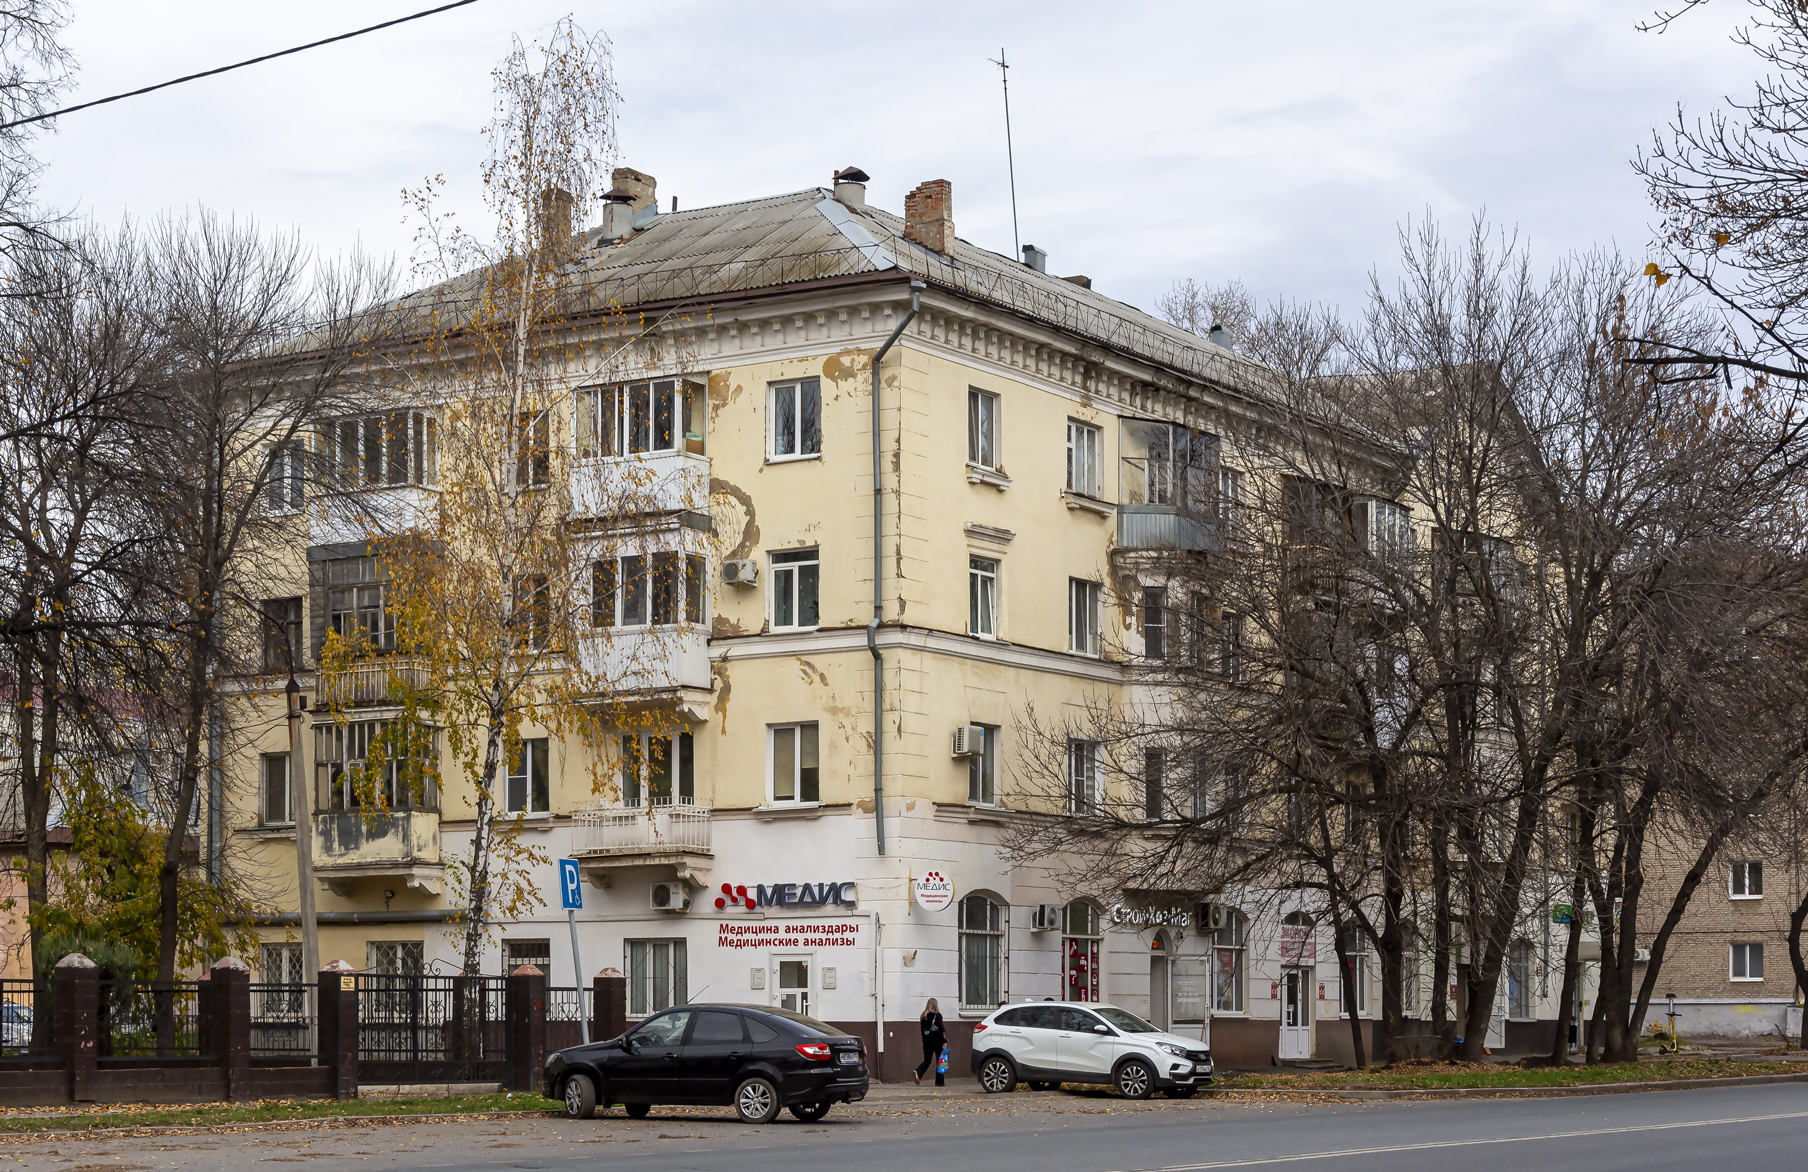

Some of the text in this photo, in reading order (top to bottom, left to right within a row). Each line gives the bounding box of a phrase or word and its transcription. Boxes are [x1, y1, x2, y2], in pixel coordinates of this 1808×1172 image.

[565, 864, 578, 904] P
[916, 882, 951, 891] МЕДИС
[756, 882, 857, 907] МЕДИС
[719, 923, 859, 937] Медицина анализдары
[718, 936, 856, 950] Медицинские анализы
